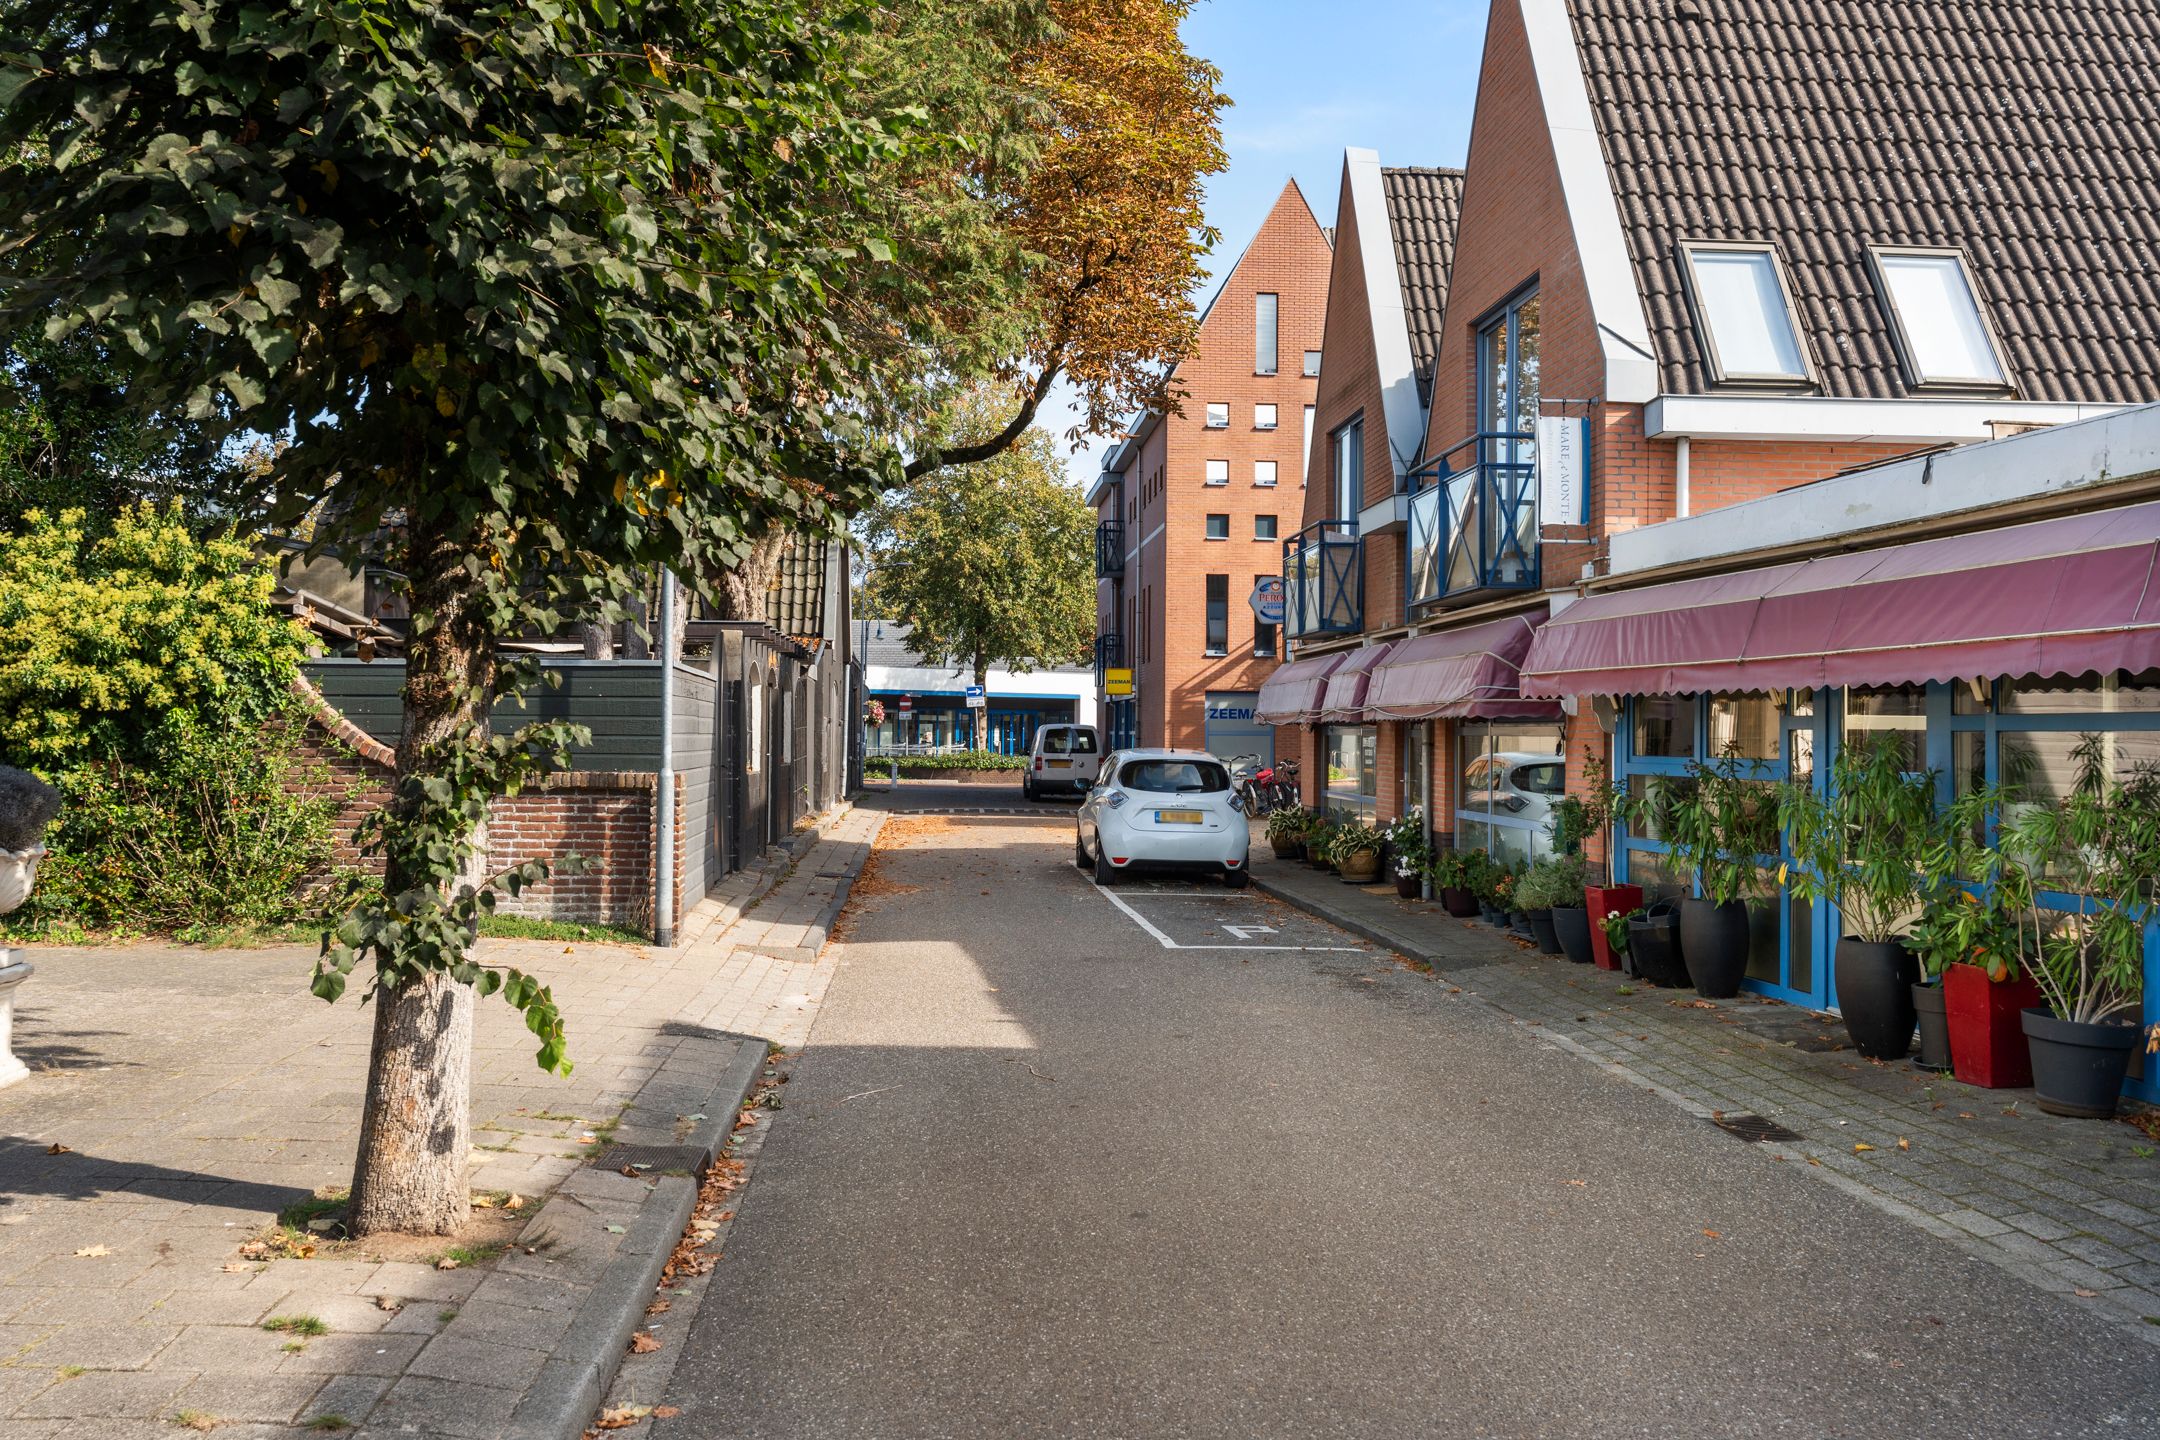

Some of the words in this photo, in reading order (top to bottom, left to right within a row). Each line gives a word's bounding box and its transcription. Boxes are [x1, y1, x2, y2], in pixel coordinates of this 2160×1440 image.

[1560, 425, 1570, 460] MARE
[1560, 473, 1570, 518] MONTE
[1259, 593, 1284, 601] PERO
[1209, 708, 1257, 720] ZEEM
